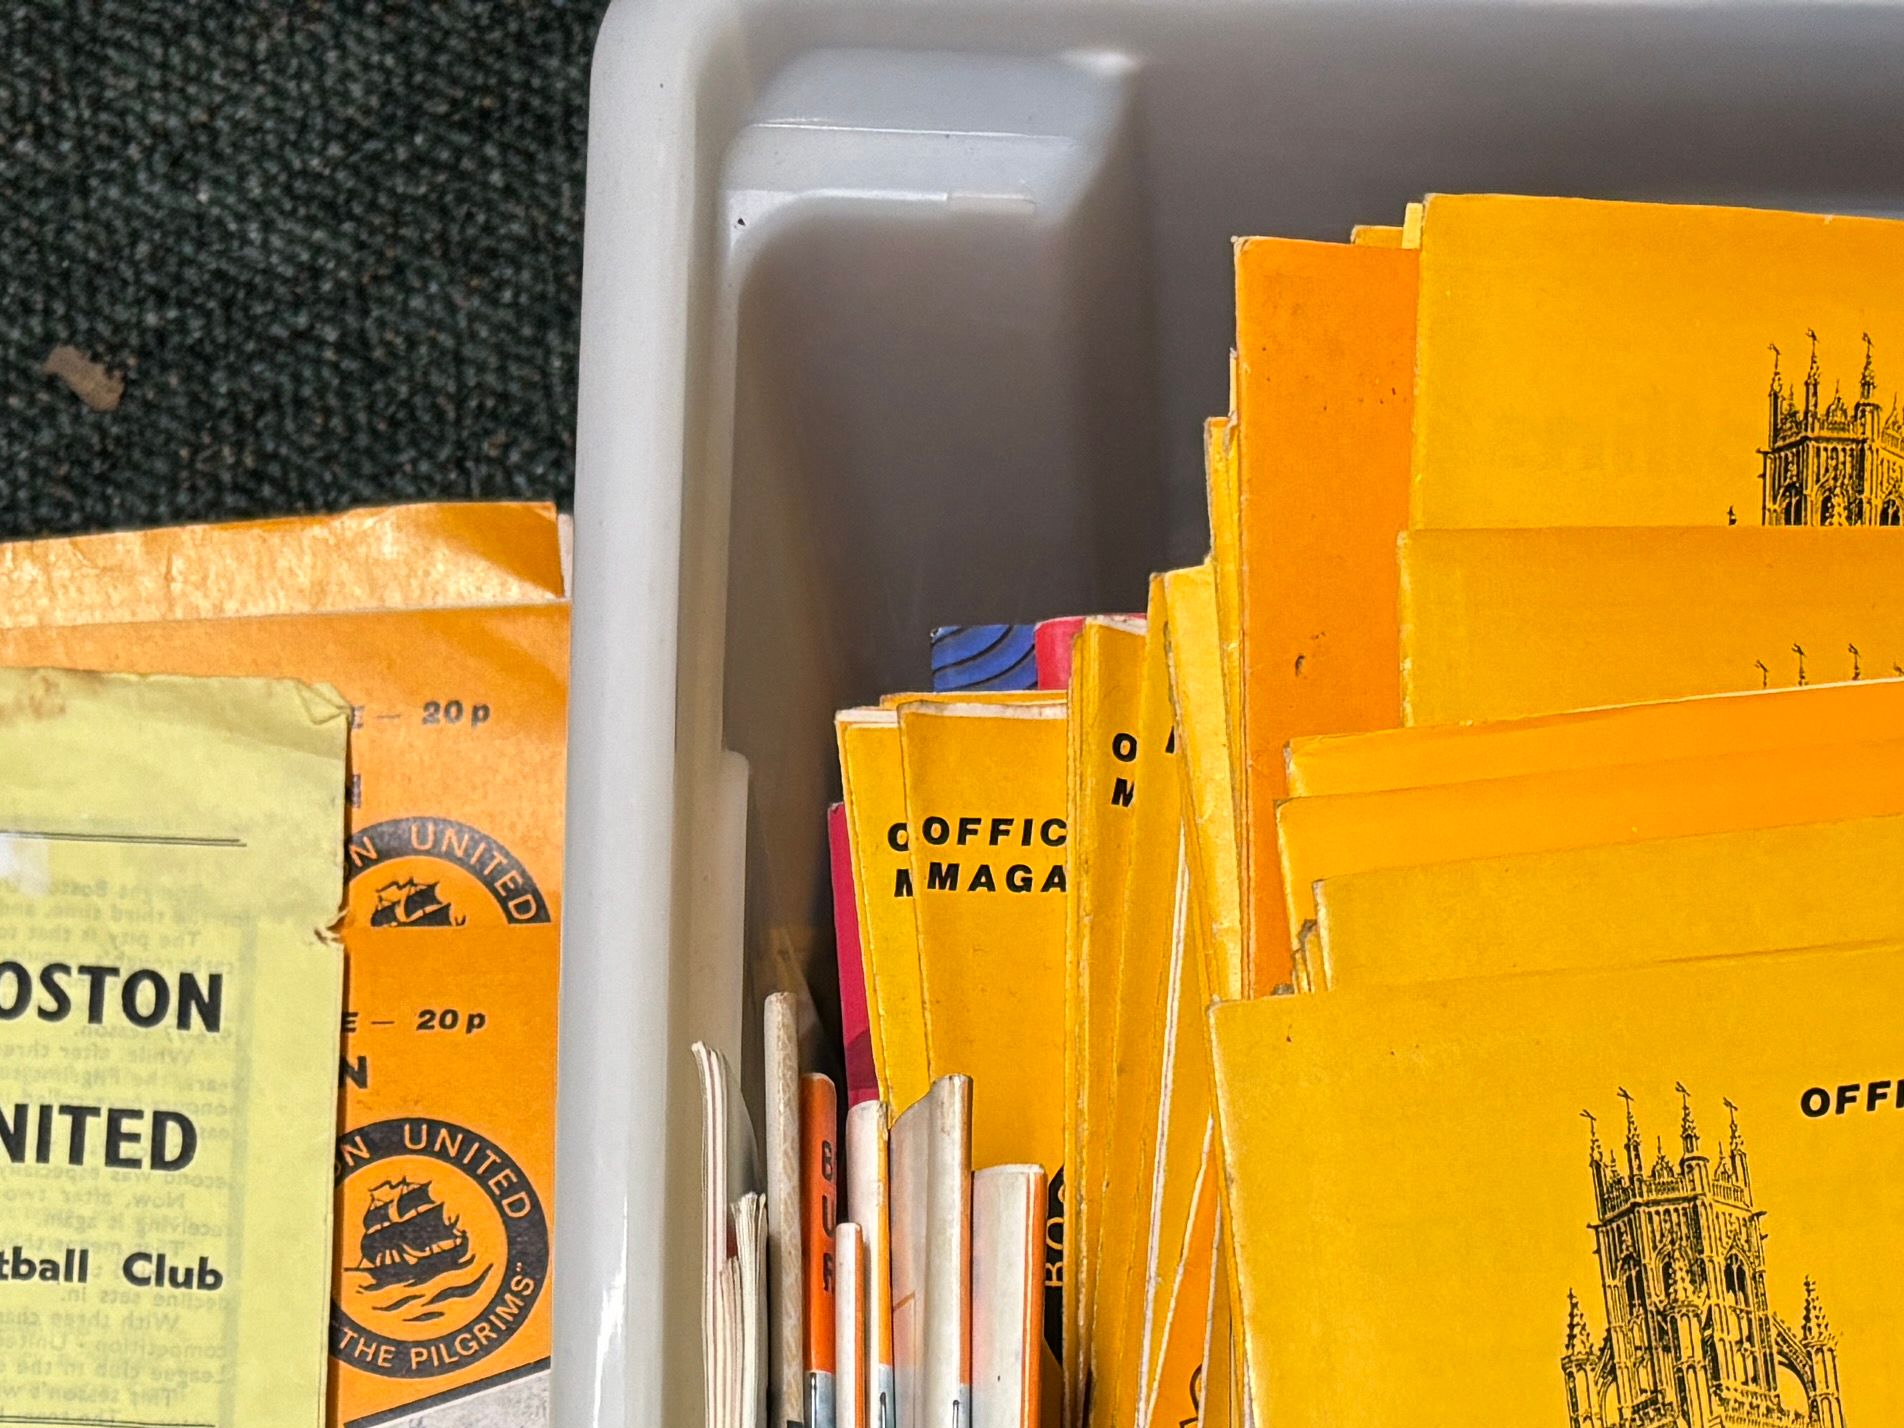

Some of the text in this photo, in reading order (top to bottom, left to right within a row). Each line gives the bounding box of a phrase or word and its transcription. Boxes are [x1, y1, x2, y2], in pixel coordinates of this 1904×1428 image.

[923, 816, 1066, 846] OFFIC
[411, 824, 537, 920] UNITED
[928, 862, 1066, 892] MAGA
[417, 1009, 485, 1033] 20p
[404, 1123, 532, 1218] UNITED
[123, 1252, 223, 1290] Club
